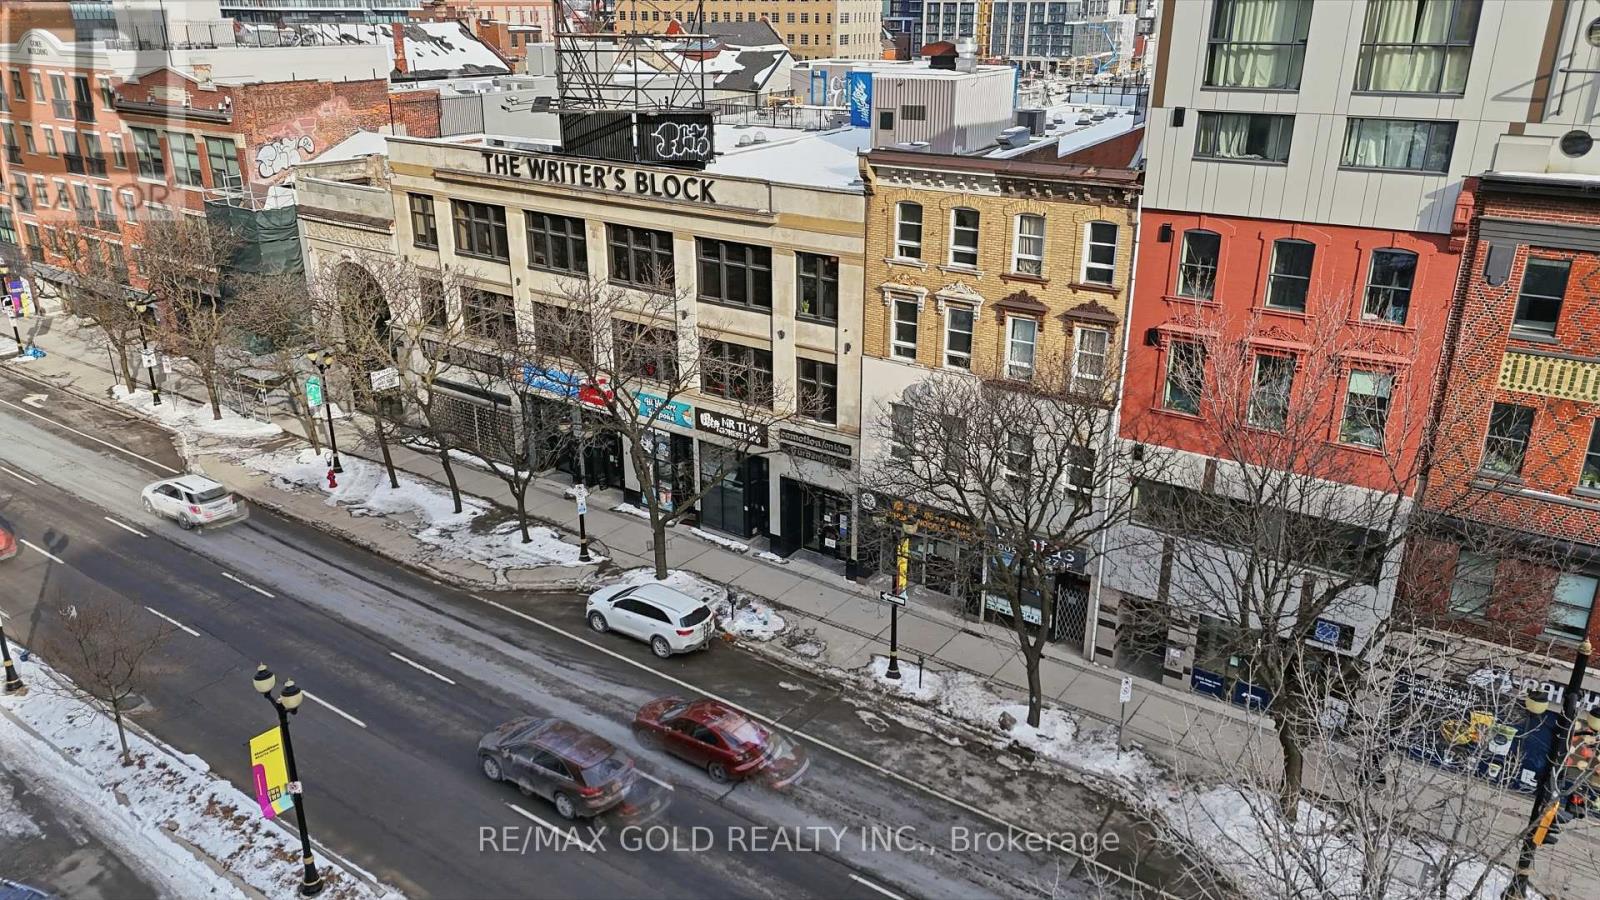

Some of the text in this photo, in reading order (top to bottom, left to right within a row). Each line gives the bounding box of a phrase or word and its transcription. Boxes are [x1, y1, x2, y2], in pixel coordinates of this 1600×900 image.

[481, 152, 716, 204] THE WRITER'S BLOCK
